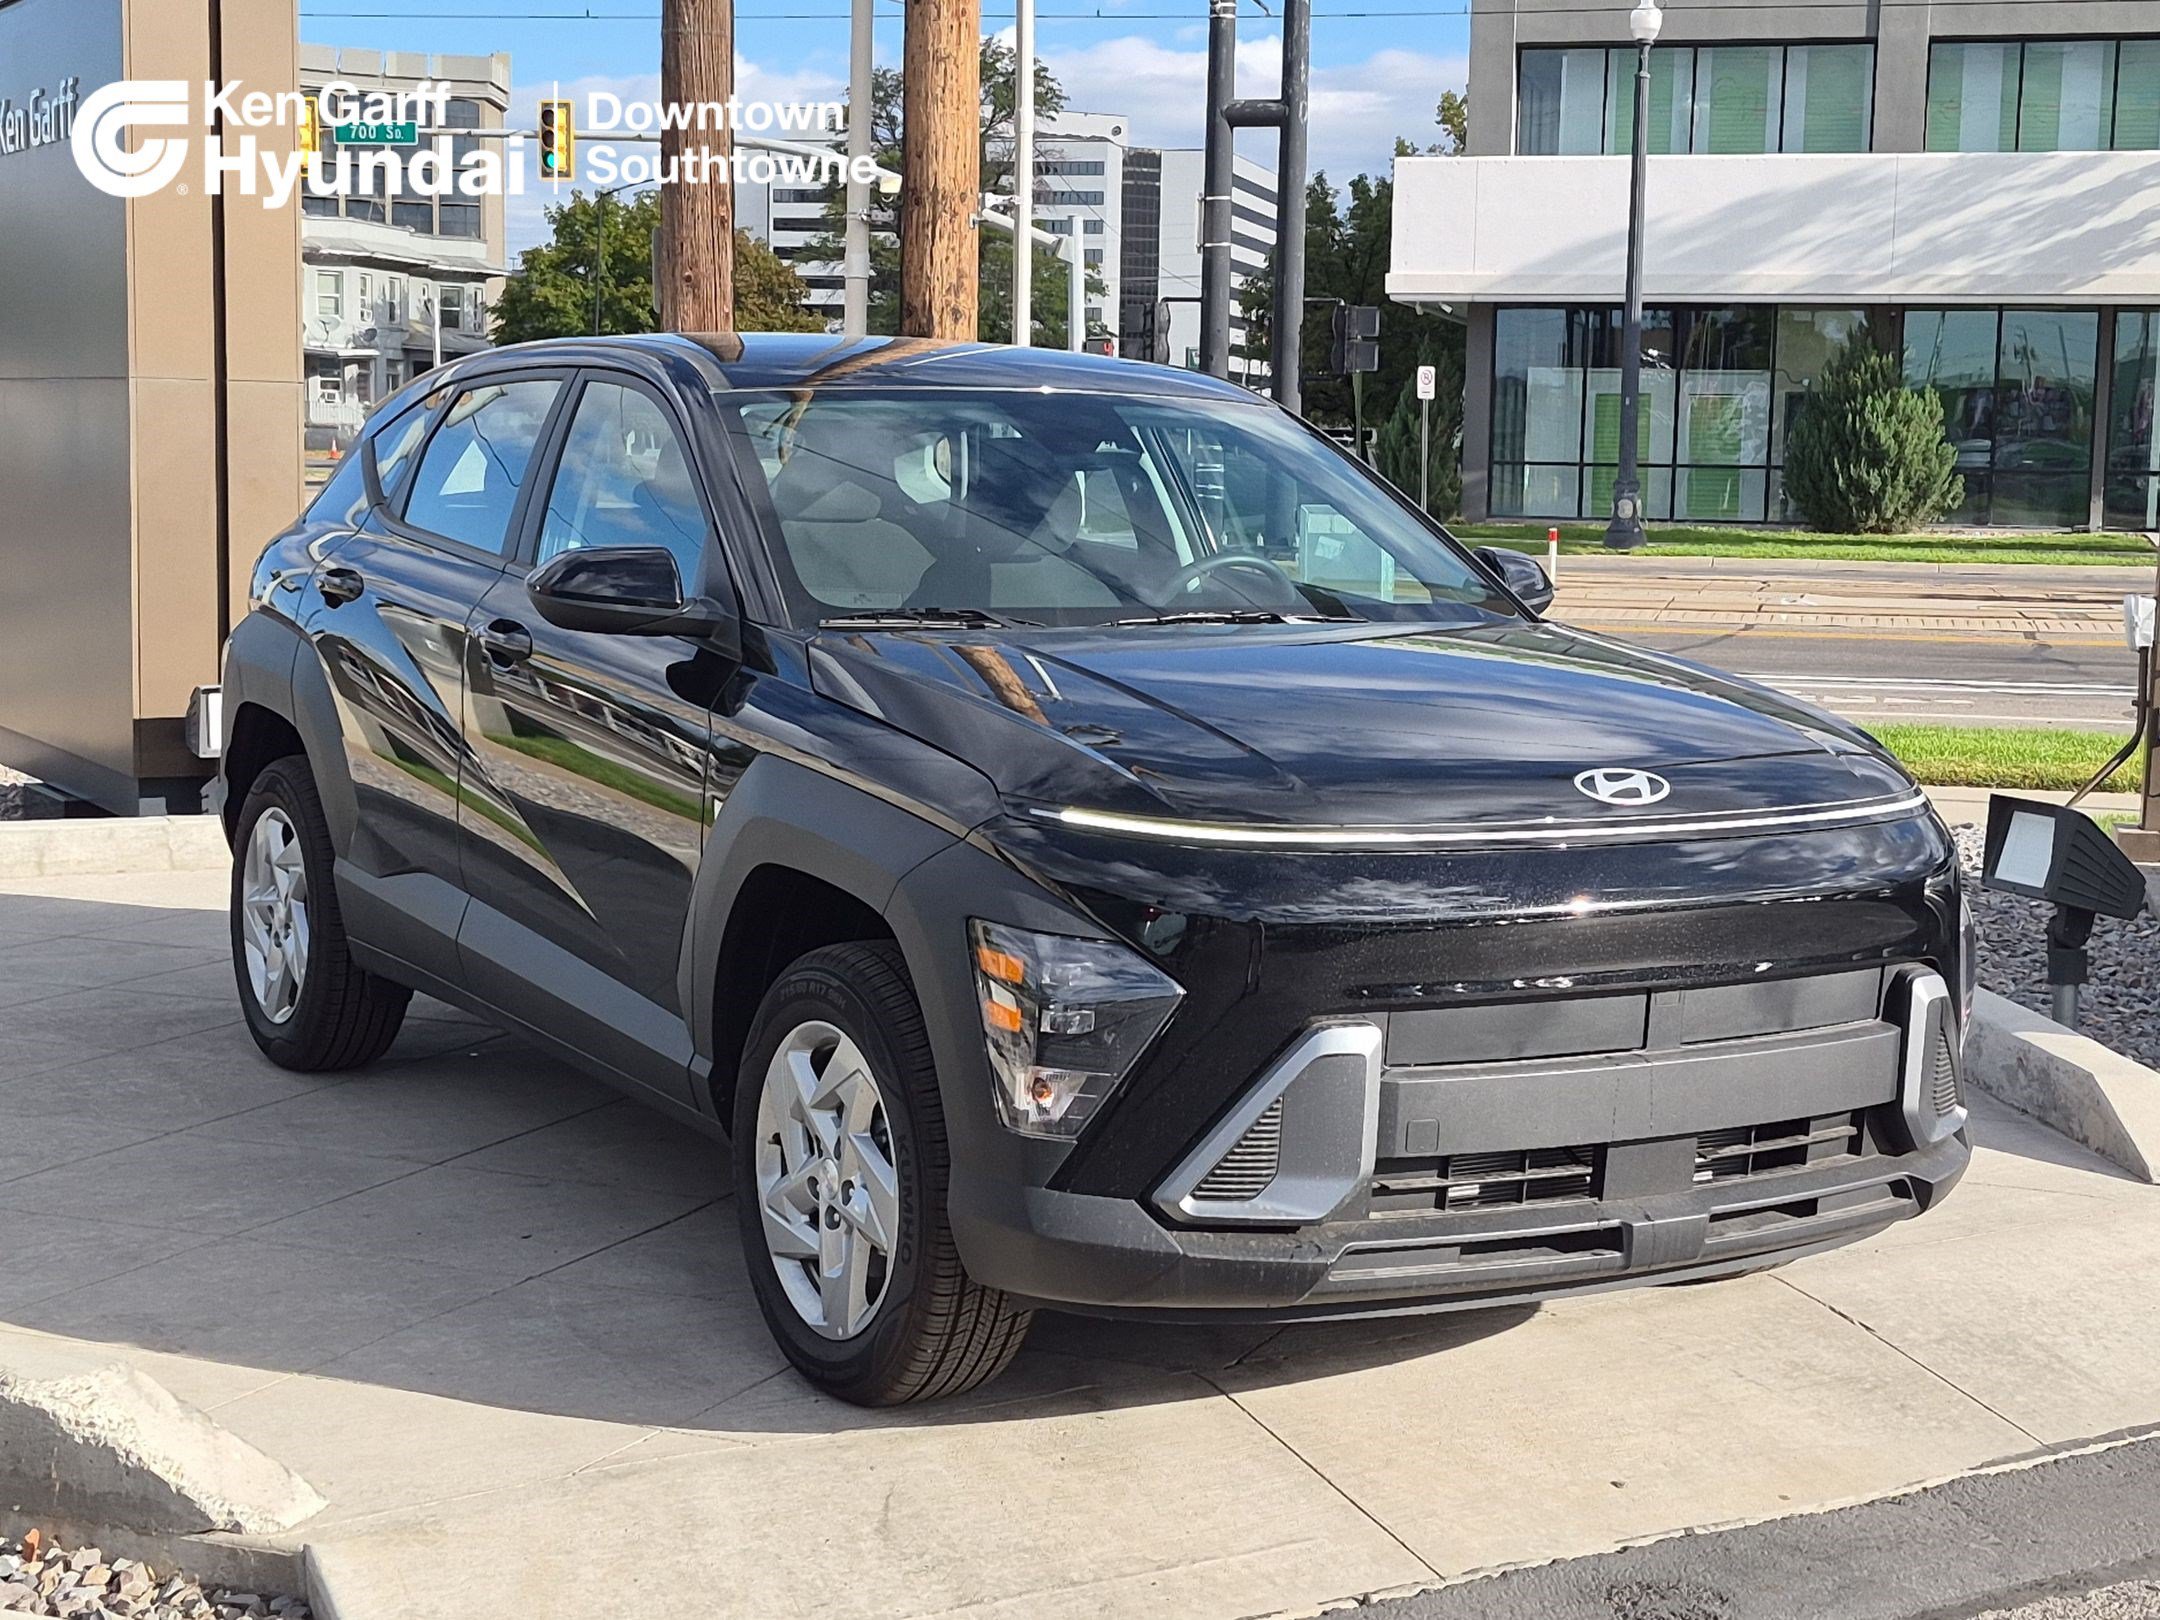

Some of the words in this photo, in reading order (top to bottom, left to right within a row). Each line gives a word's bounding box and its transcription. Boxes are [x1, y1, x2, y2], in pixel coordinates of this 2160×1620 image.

[30, 76, 77, 147] Garff
[349, 125, 376, 139] 700
[897, 1134, 914, 1265] KUMHO
